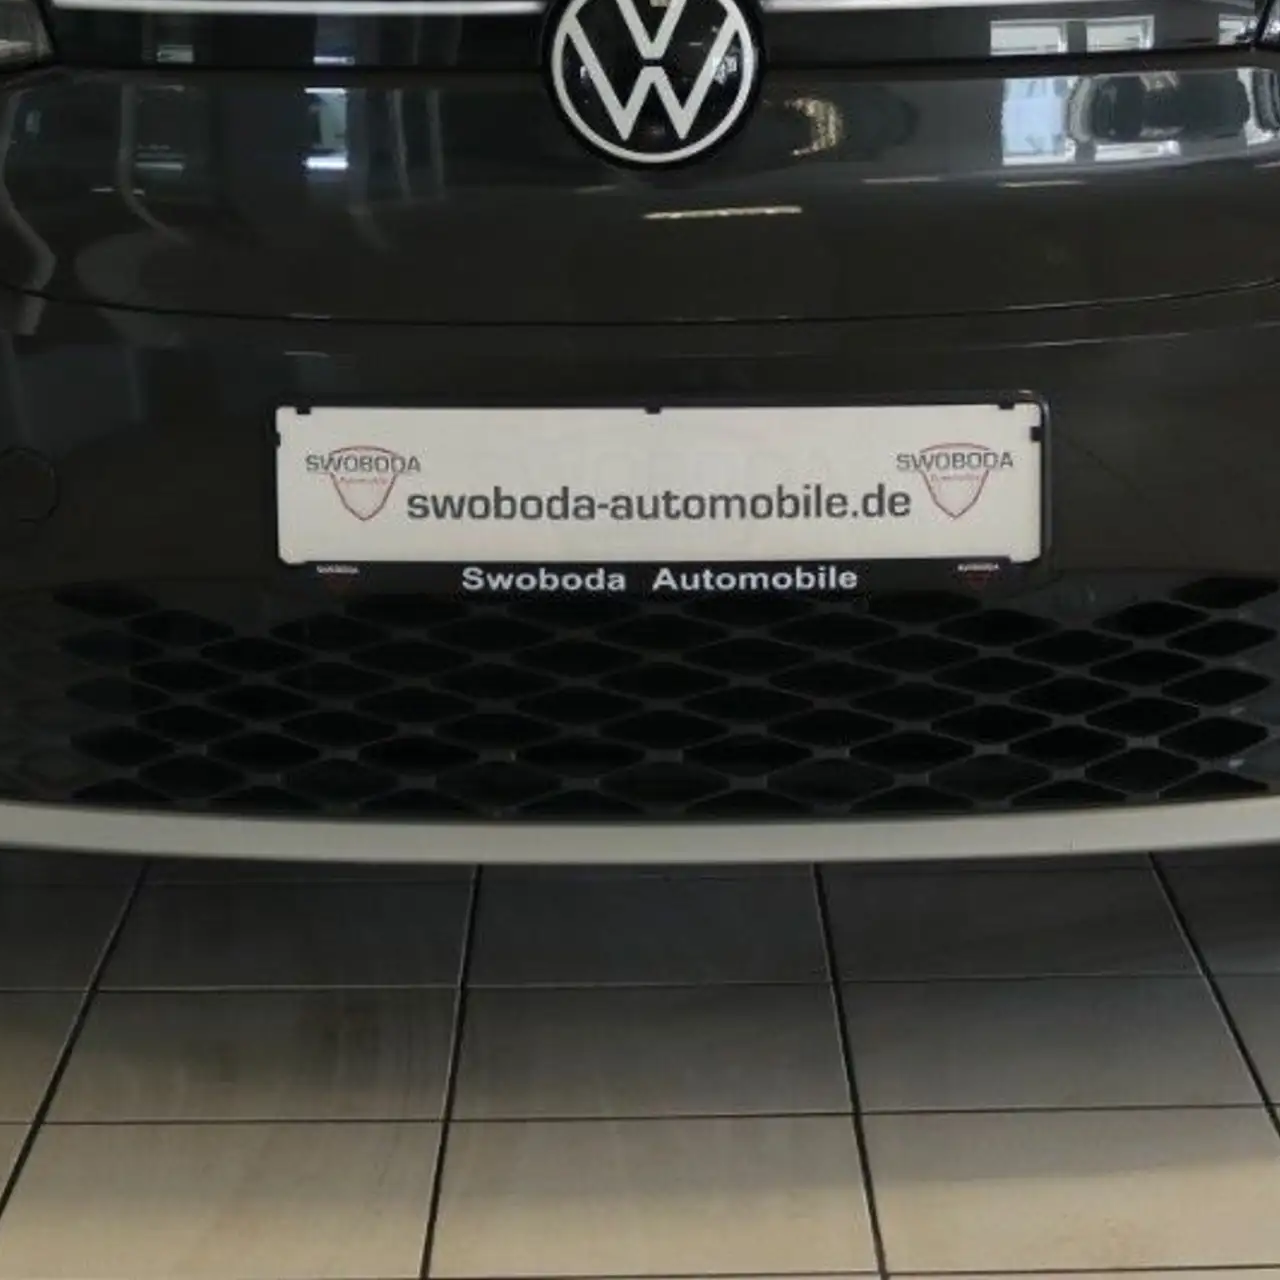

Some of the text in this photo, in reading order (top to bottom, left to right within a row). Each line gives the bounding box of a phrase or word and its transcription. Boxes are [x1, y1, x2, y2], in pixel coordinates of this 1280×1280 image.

[305, 453, 422, 474] SWOBODA
[895, 451, 1014, 472] SWOBODA
[406, 483, 912, 521] swoboda-automobile.de
[461, 565, 859, 592] Swoboda Automobile
